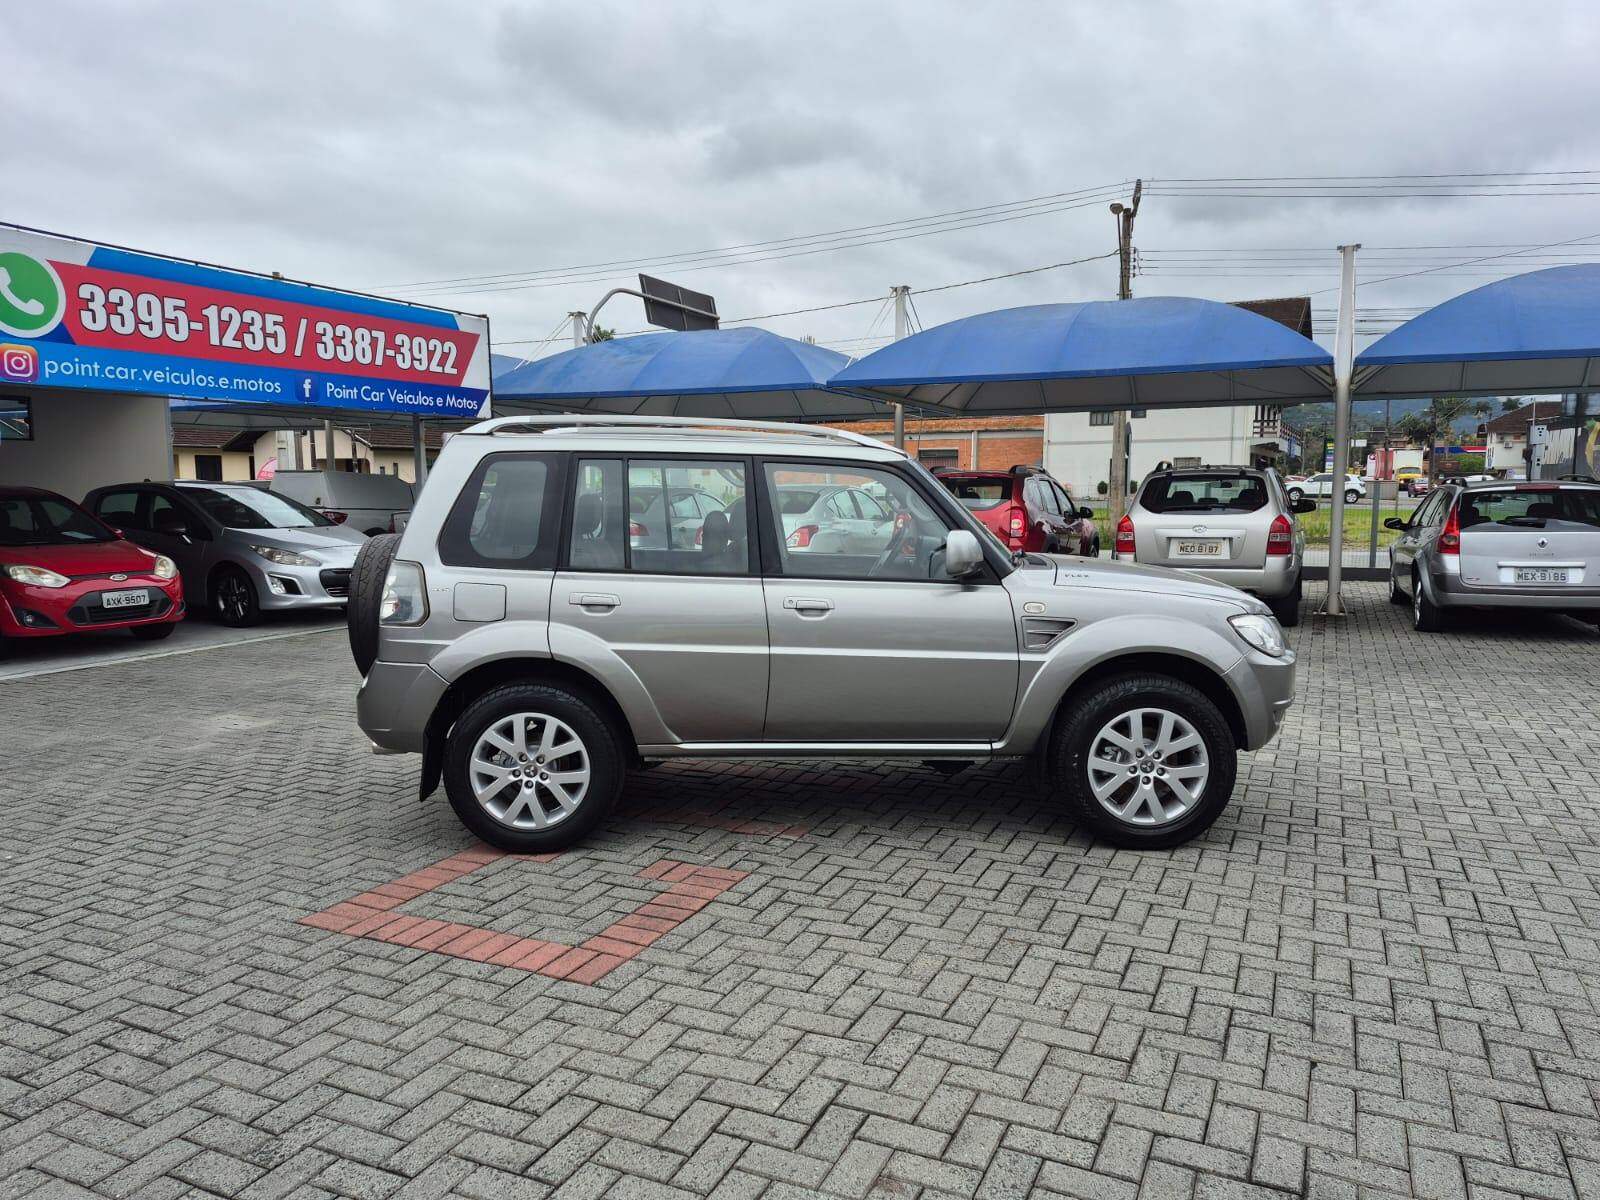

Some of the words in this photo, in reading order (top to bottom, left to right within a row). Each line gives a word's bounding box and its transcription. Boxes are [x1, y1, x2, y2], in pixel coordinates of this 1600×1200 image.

[78, 283, 287, 354] 3395-1235
[294, 318, 308, 357] /
[315, 321, 458, 375] 3387-3922
[44, 357, 282, 394] point.car.veiculos.e.motos
[326, 382, 358, 399] Point
[360, 386, 385, 402] Car
[387, 388, 434, 407] Veículos
[436, 397, 443, 407] e
[445, 394, 478, 410] Motos
